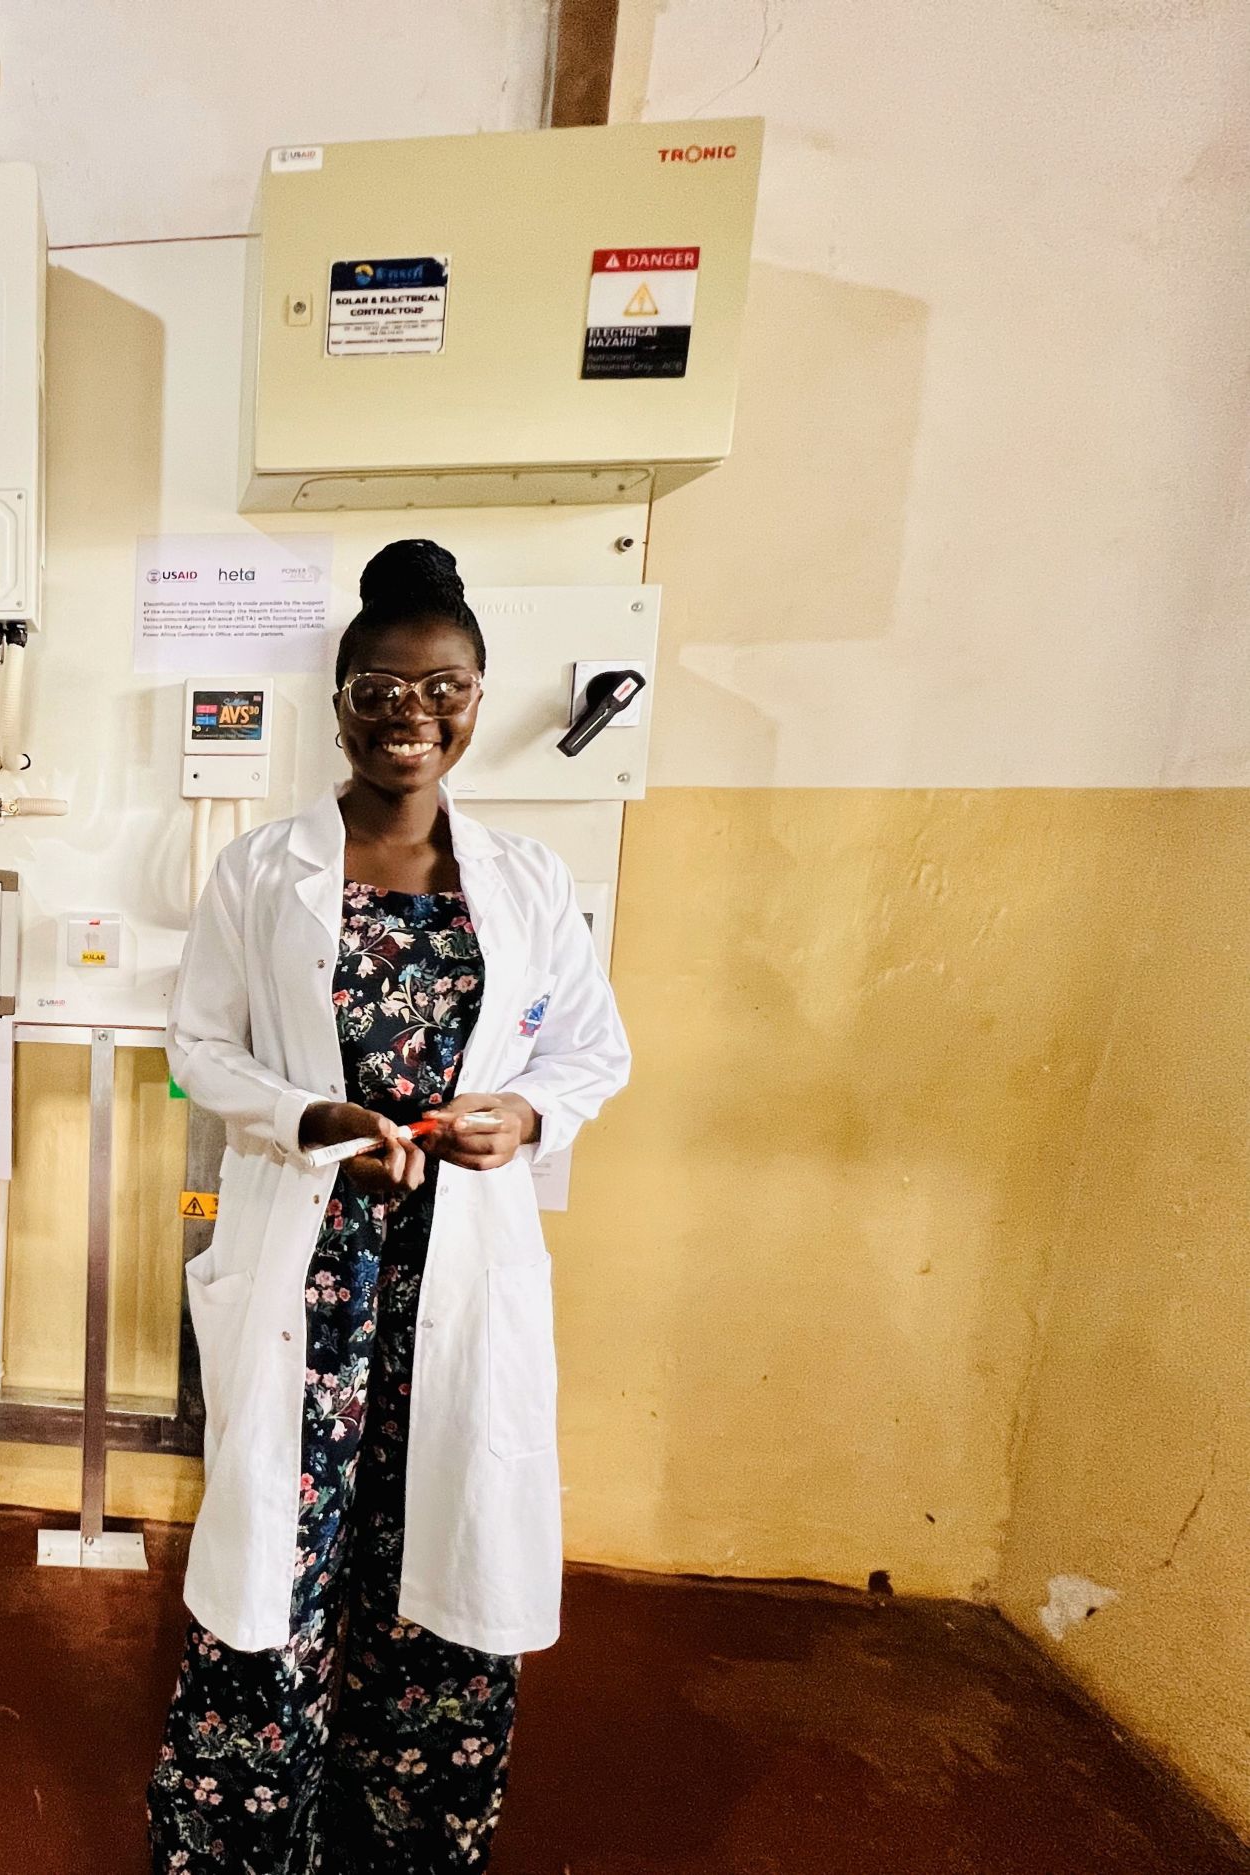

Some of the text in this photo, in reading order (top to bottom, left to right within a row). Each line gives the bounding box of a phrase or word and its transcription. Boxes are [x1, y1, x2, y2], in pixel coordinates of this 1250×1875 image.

[657, 144, 737, 164] TRONIC
[626, 251, 695, 268] DANGER
[335, 296, 368, 306] SOLAR
[380, 293, 440, 303] ELECTRICAL
[350, 306, 424, 317] CONTRACTORS
[588, 326, 658, 338] ELECTRICAL
[587, 337, 637, 348] HAZARD
[162, 570, 198, 580] USAID
[218, 567, 256, 581] heta
[81, 953, 106, 961] SOLAR
